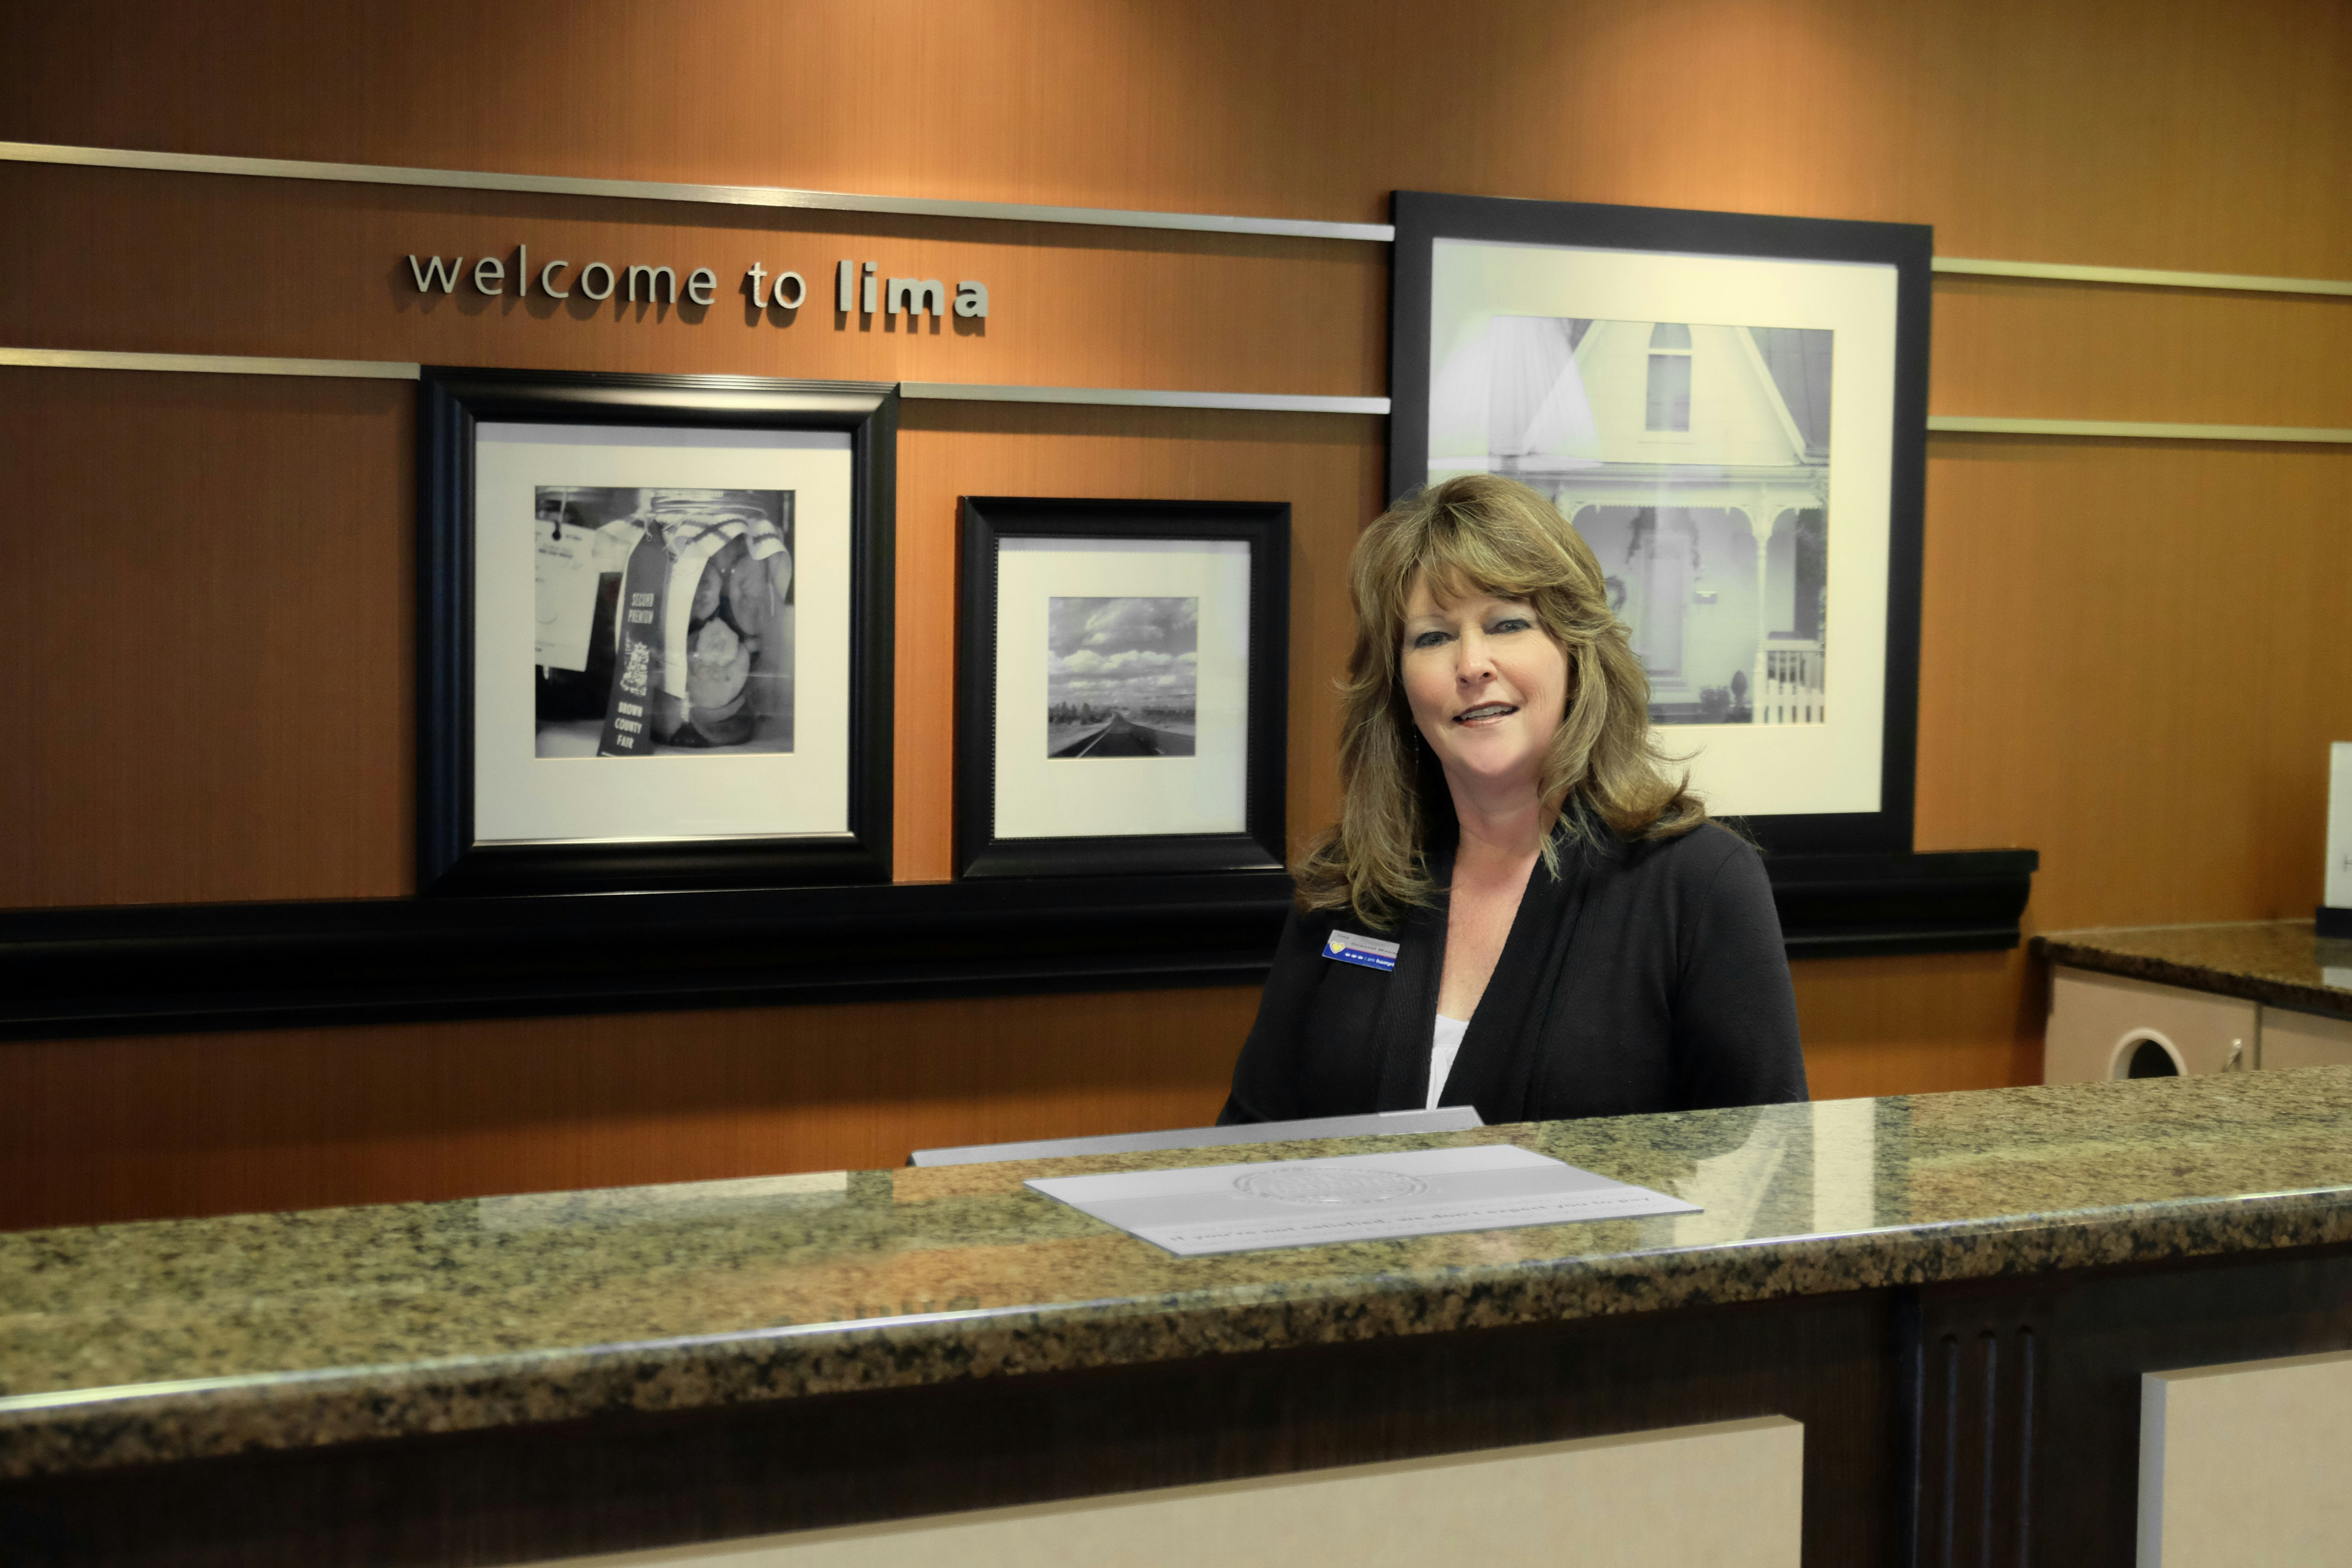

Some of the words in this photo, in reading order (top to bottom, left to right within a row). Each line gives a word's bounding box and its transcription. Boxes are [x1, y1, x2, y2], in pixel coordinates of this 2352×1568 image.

[408, 244, 718, 306] welcome
[748, 262, 807, 309] to
[839, 260, 989, 318] lima
[618, 701, 643, 718] BROWN
[614, 717, 643, 735] COUNTY
[616, 734, 635, 749] FAIR
[1486, 1205, 1546, 1214] expect
